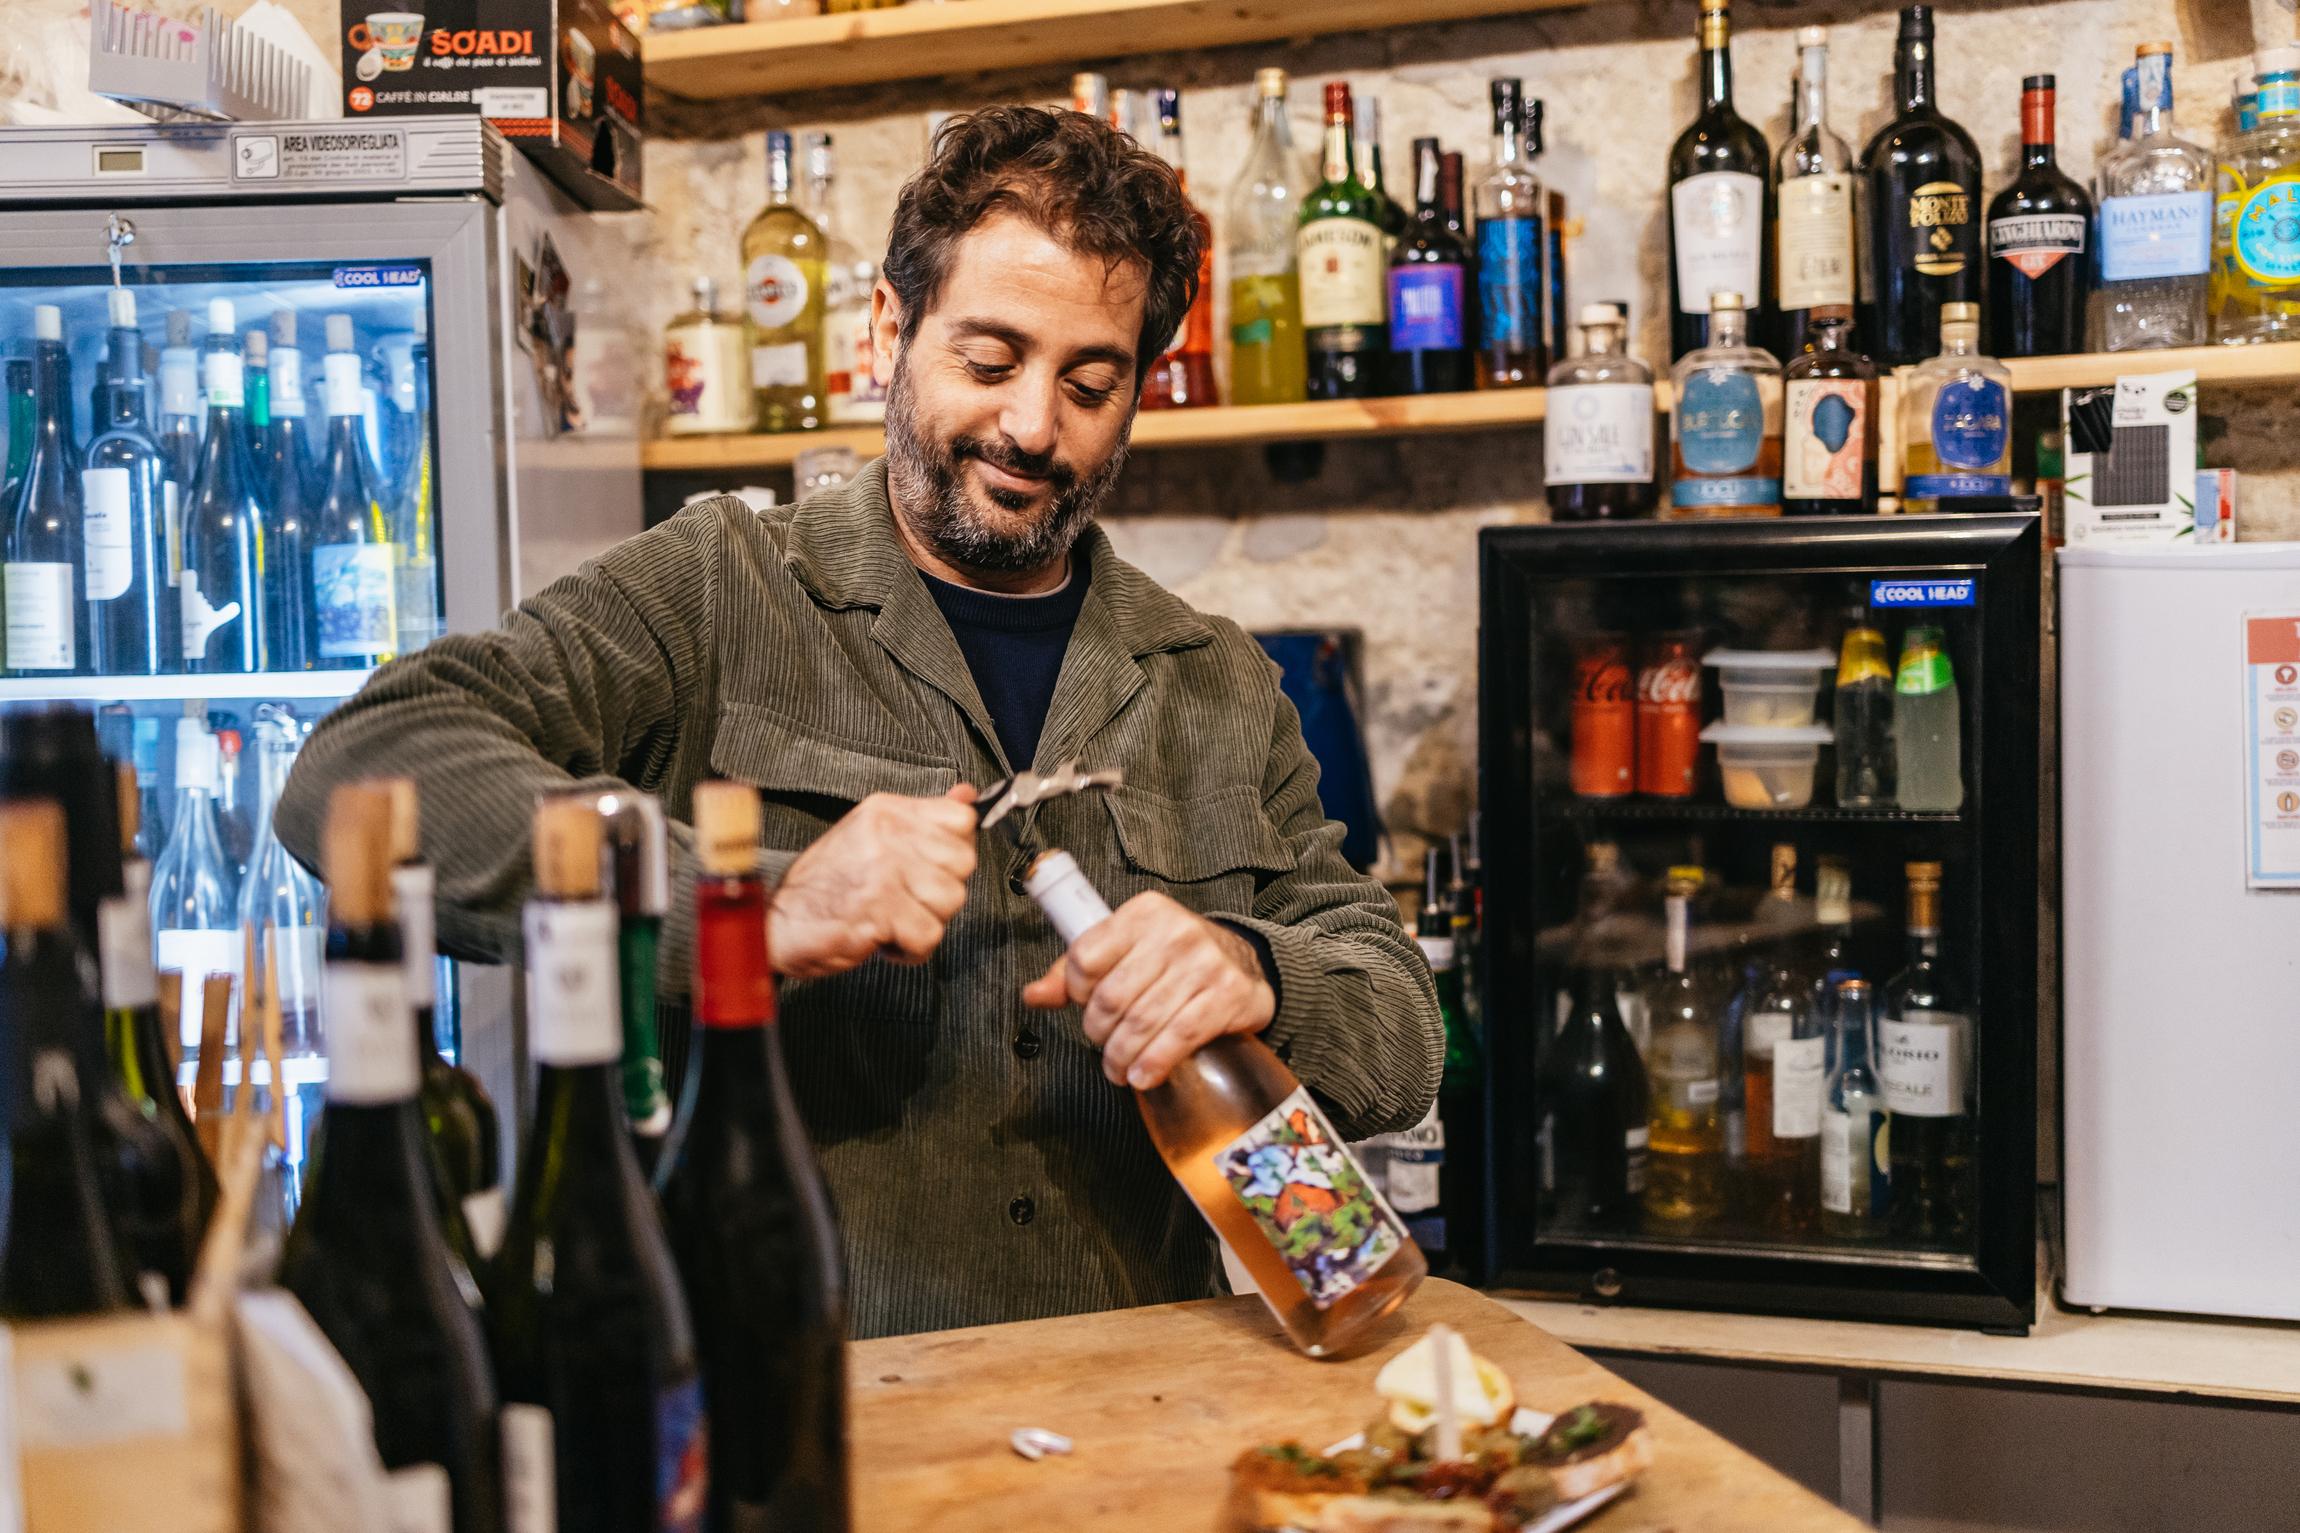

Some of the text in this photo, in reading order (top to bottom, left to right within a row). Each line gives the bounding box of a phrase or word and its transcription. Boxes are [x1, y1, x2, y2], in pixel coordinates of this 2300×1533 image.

[283, 133, 399, 152] AREA VIDEOSORVEGLIATA
[1910, 194, 1968, 212] MONTE
[344, 271, 380, 285] COOL
[1886, 585, 1968, 602] COOL HEAD
